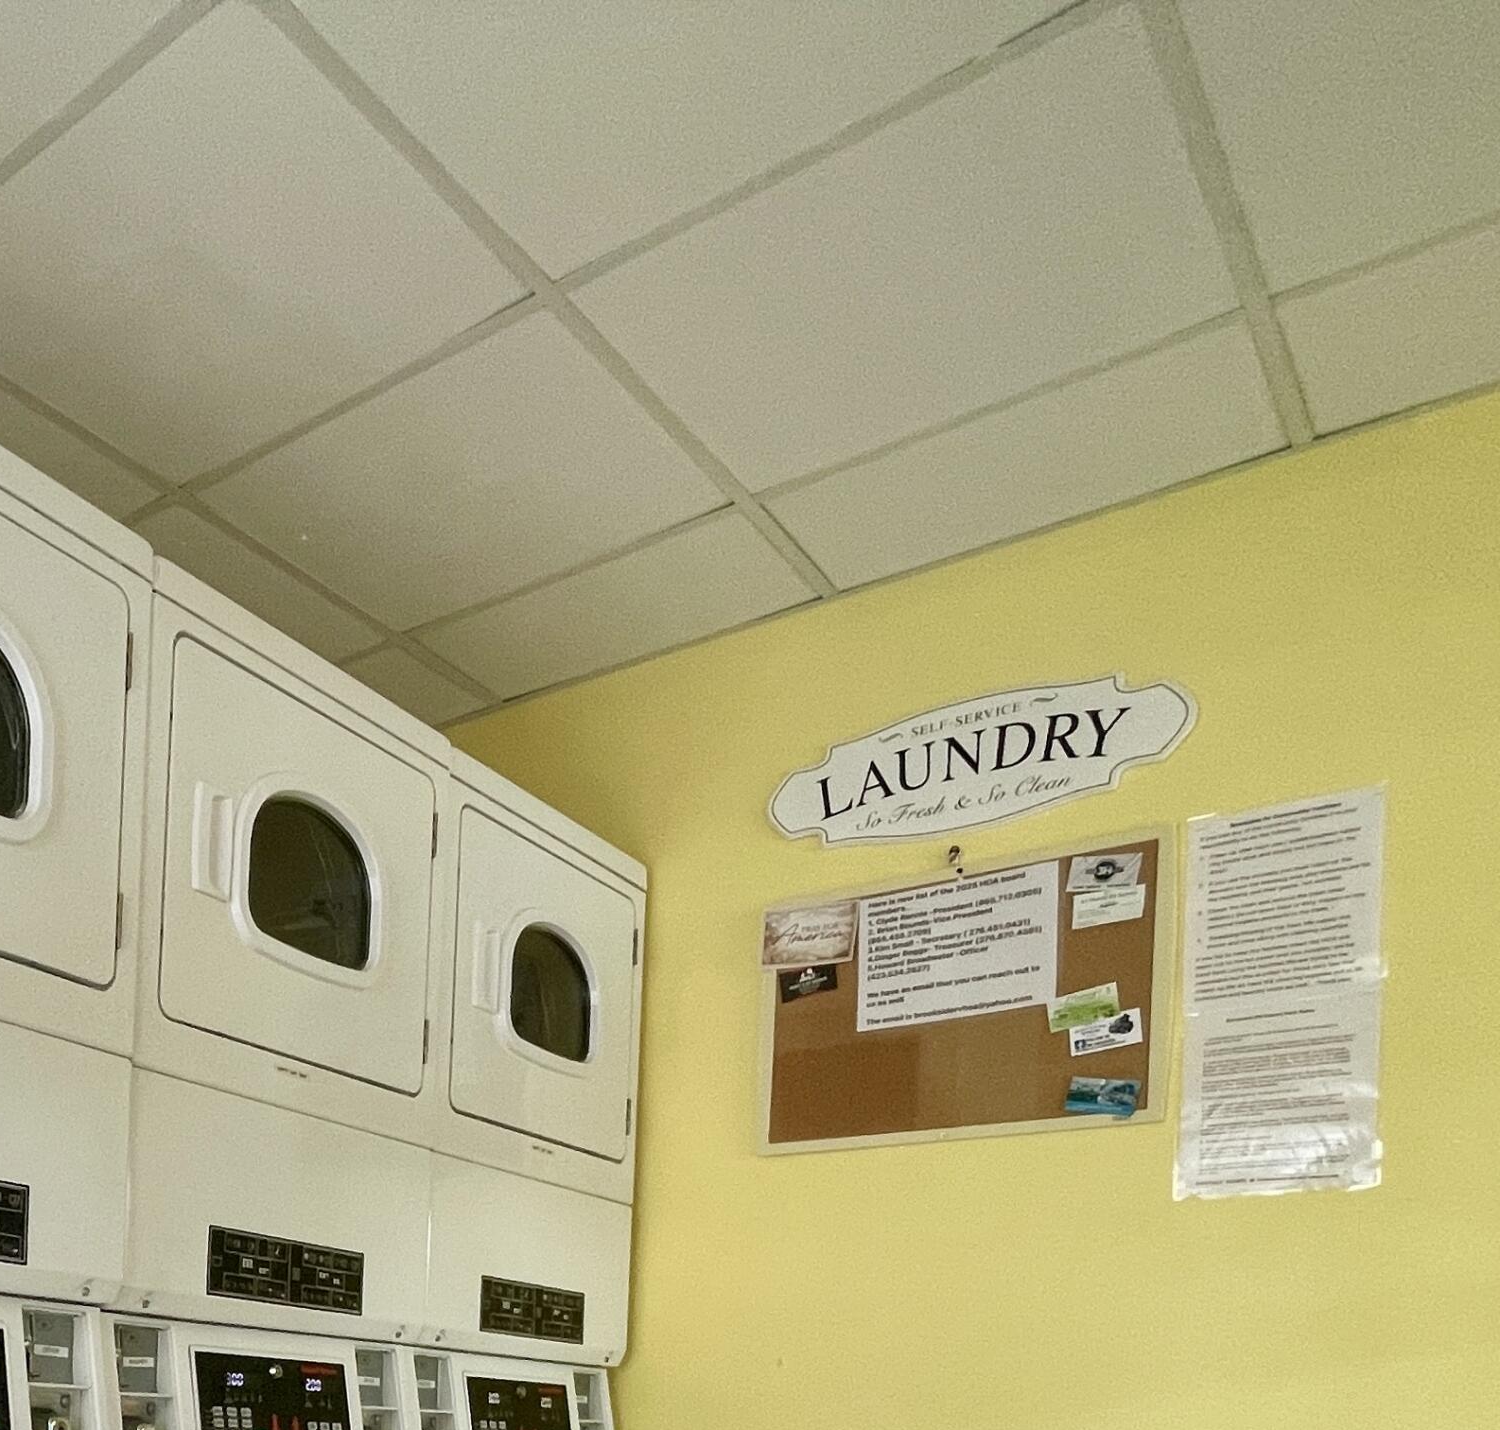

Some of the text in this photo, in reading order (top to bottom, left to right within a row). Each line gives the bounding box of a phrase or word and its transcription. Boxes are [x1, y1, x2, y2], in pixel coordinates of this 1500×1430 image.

[910, 701, 1022, 738] SELF-SERVICE
[816, 706, 1132, 821] LAUNDRY
[856, 774, 1074, 832] So Fresh & So Clean
